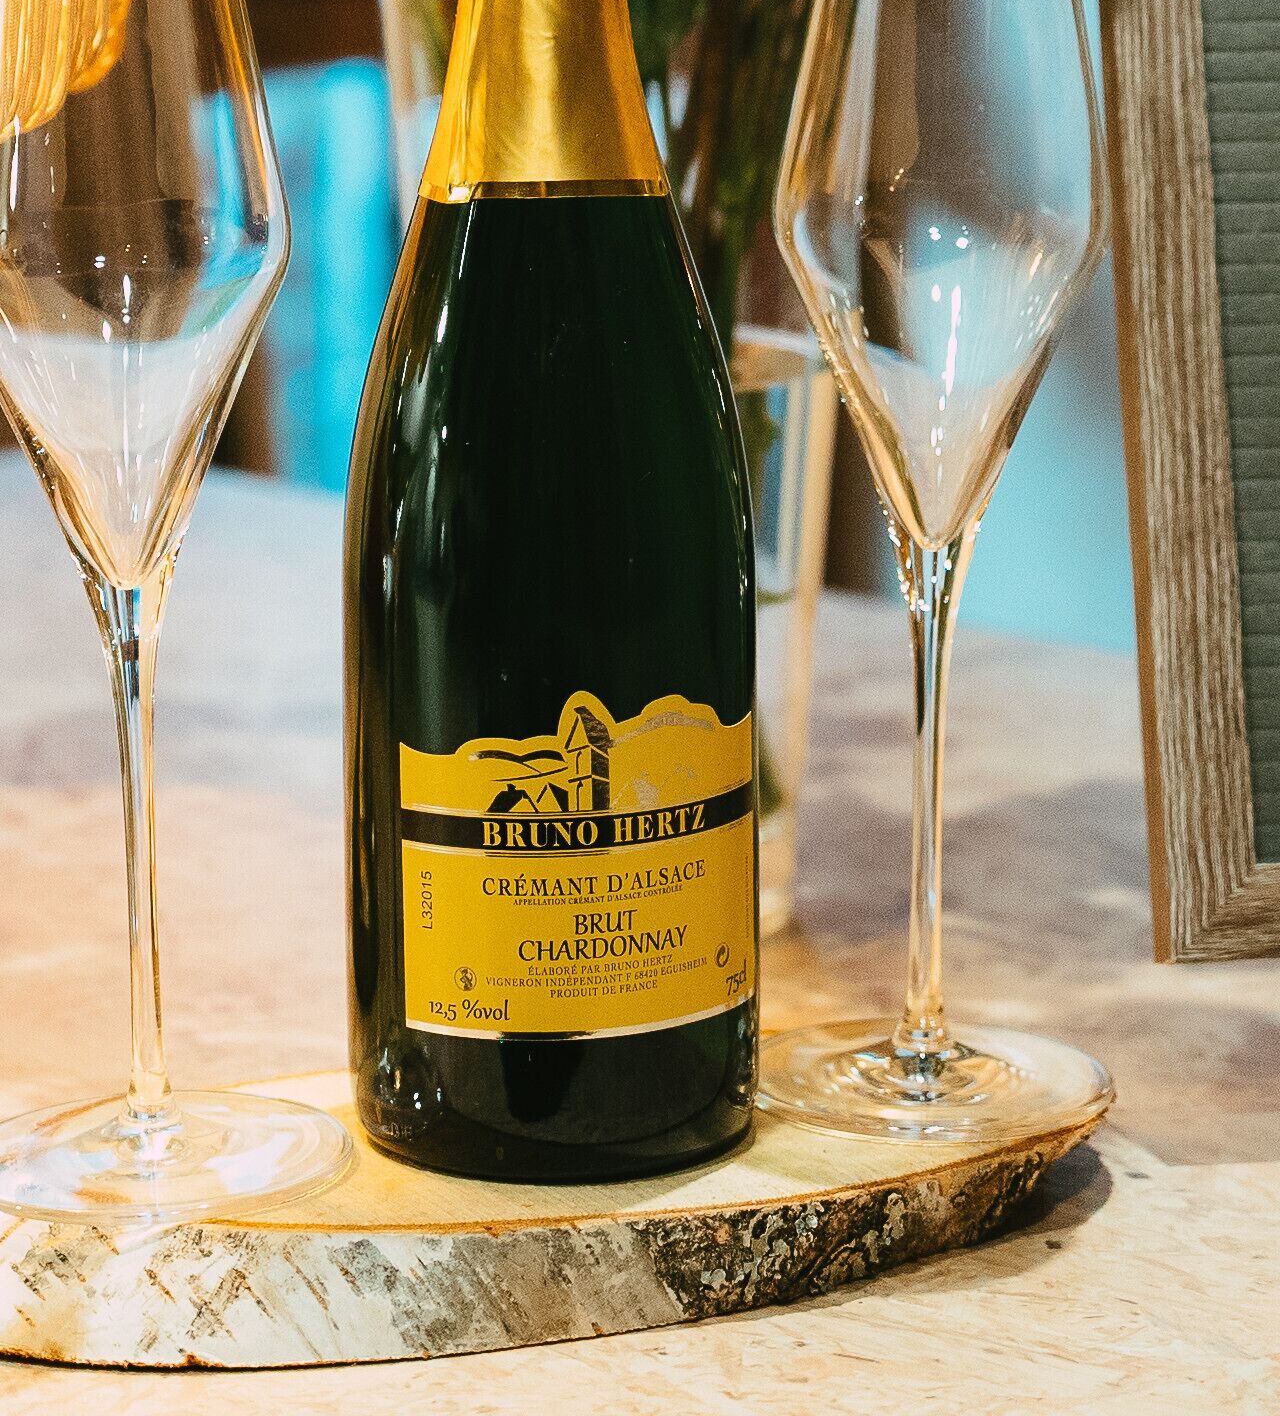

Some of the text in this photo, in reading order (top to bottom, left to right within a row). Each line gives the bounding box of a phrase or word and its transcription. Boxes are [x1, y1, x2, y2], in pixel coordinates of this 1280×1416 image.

[482, 804, 706, 847] BRUNO HERTZ
[482, 859, 706, 896] CRÉMANT D'ALSACE
[421, 871, 433, 929] L32015
[513, 898, 566, 906] APPELLATION
[568, 896, 604, 905] CRÉMANT
[607, 891, 641, 902] D'ALSACE
[573, 909, 638, 935] BRUT
[518, 925, 688, 961] CHARDONNAY
[486, 956, 708, 987] VIGNERON INDÉPENDANT F 68420 EGUISHEIM
[528, 954, 673, 976] ÉLABORÉ PAR BRUNO HERTZ
[726, 957, 747, 996] 75cl
[550, 980, 658, 998] PRODUIT DE FRANCE
[429, 999, 510, 1021] 12,5 %vol
